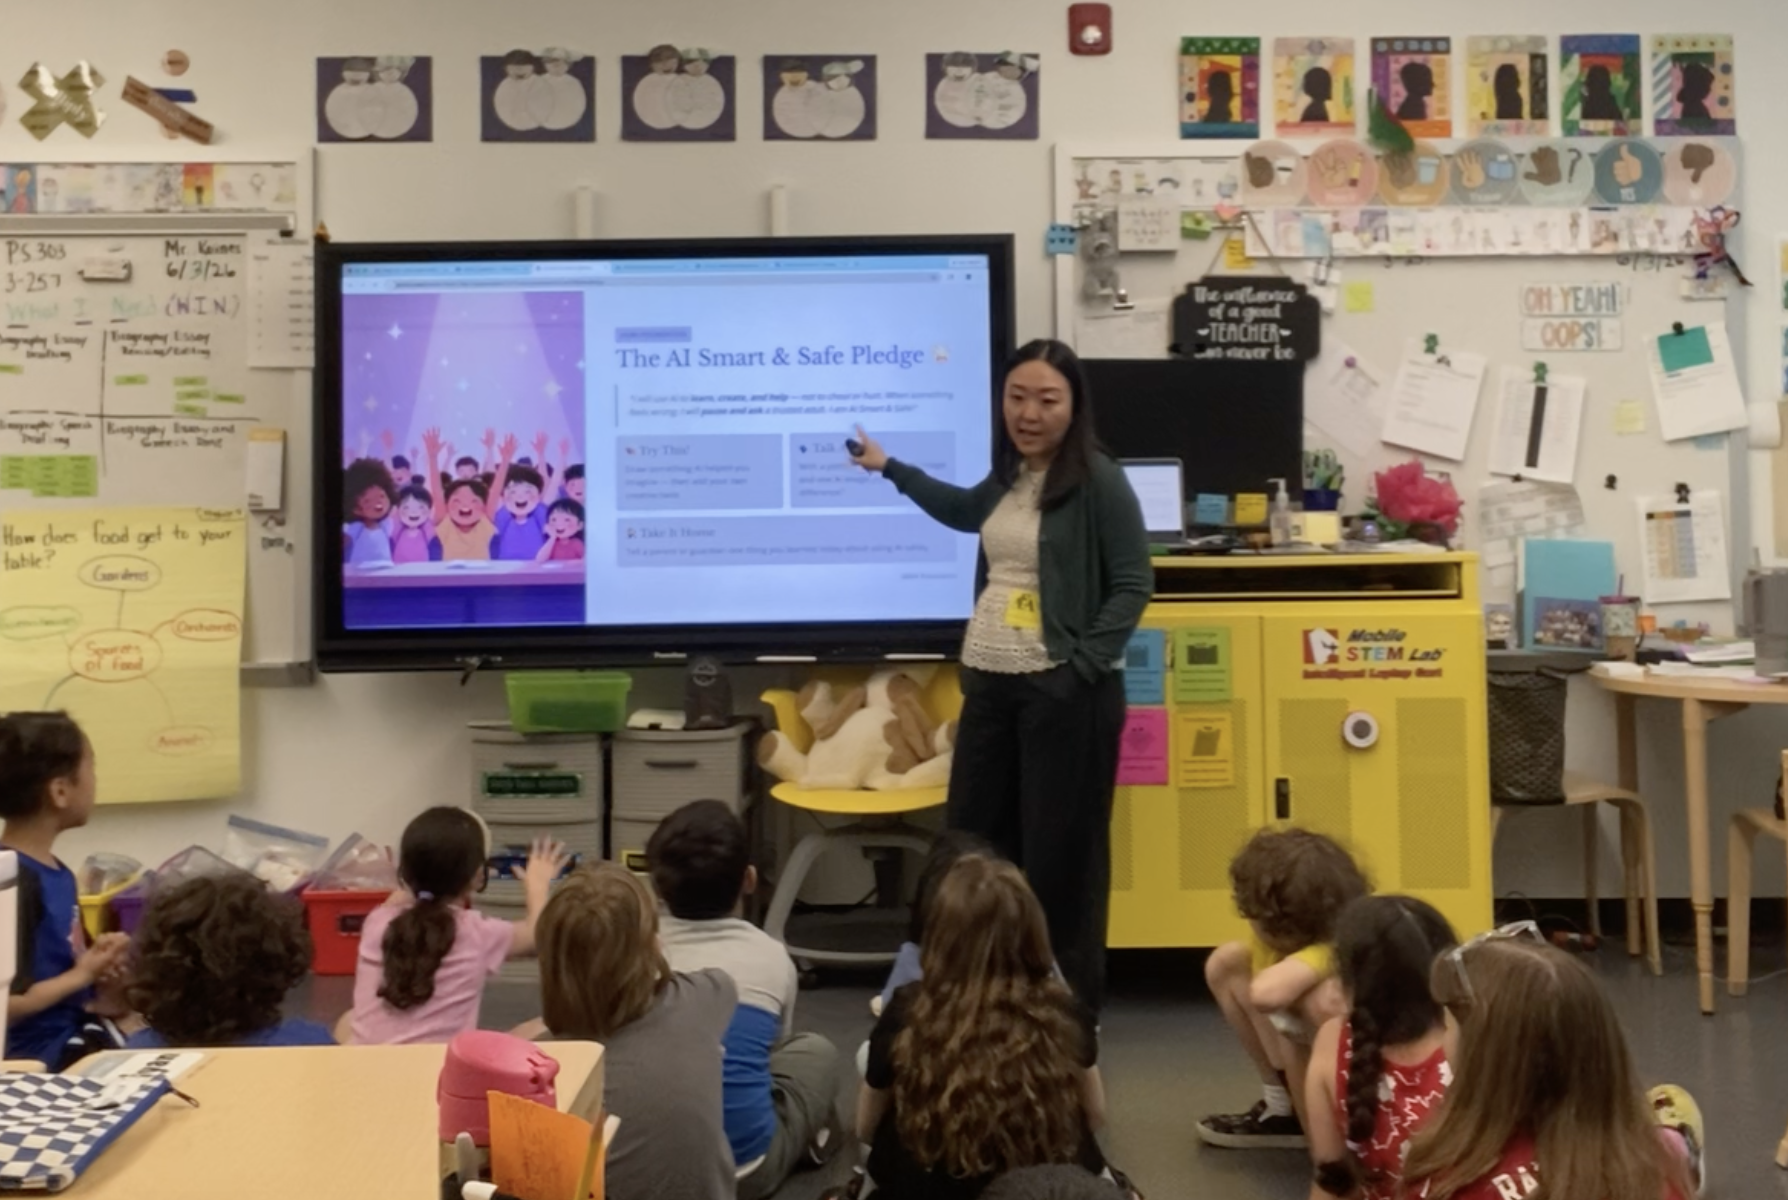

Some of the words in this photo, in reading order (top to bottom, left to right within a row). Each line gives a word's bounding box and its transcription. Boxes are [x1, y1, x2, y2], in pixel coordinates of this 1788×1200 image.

[5, 240, 31, 265] PS
[166, 259, 237, 280] 6/3/26
[5, 271, 61, 293] 3-257
[1194, 286, 1220, 302] The
[1223, 286, 1297, 304] influence
[1524, 286, 1552, 312] OH
[1559, 283, 1617, 313] YEAH!
[1208, 303, 1225, 320] of
[1227, 306, 1239, 318] a
[1242, 303, 1281, 323] good
[1209, 323, 1280, 343] TEACHER
[1541, 320, 1602, 348] OOPS!
[616, 348, 661, 368] The
[666, 348, 691, 368] AI
[698, 348, 766, 368] Smart
[772, 346, 791, 366] &
[798, 344, 845, 366] Safe
[851, 344, 925, 369] Pledge
[1226, 346, 1271, 359] never
[1274, 343, 1296, 360] be
[3, 523, 37, 547] How
[42, 522, 79, 547] does
[92, 518, 130, 545] food
[136, 524, 164, 551] get
[172, 523, 190, 541] to
[199, 529, 233, 547] your
[4, 548, 58, 573] table?
[1346, 628, 1407, 643] Mobile
[112, 655, 144, 672] food
[1346, 646, 1404, 662] STEM
